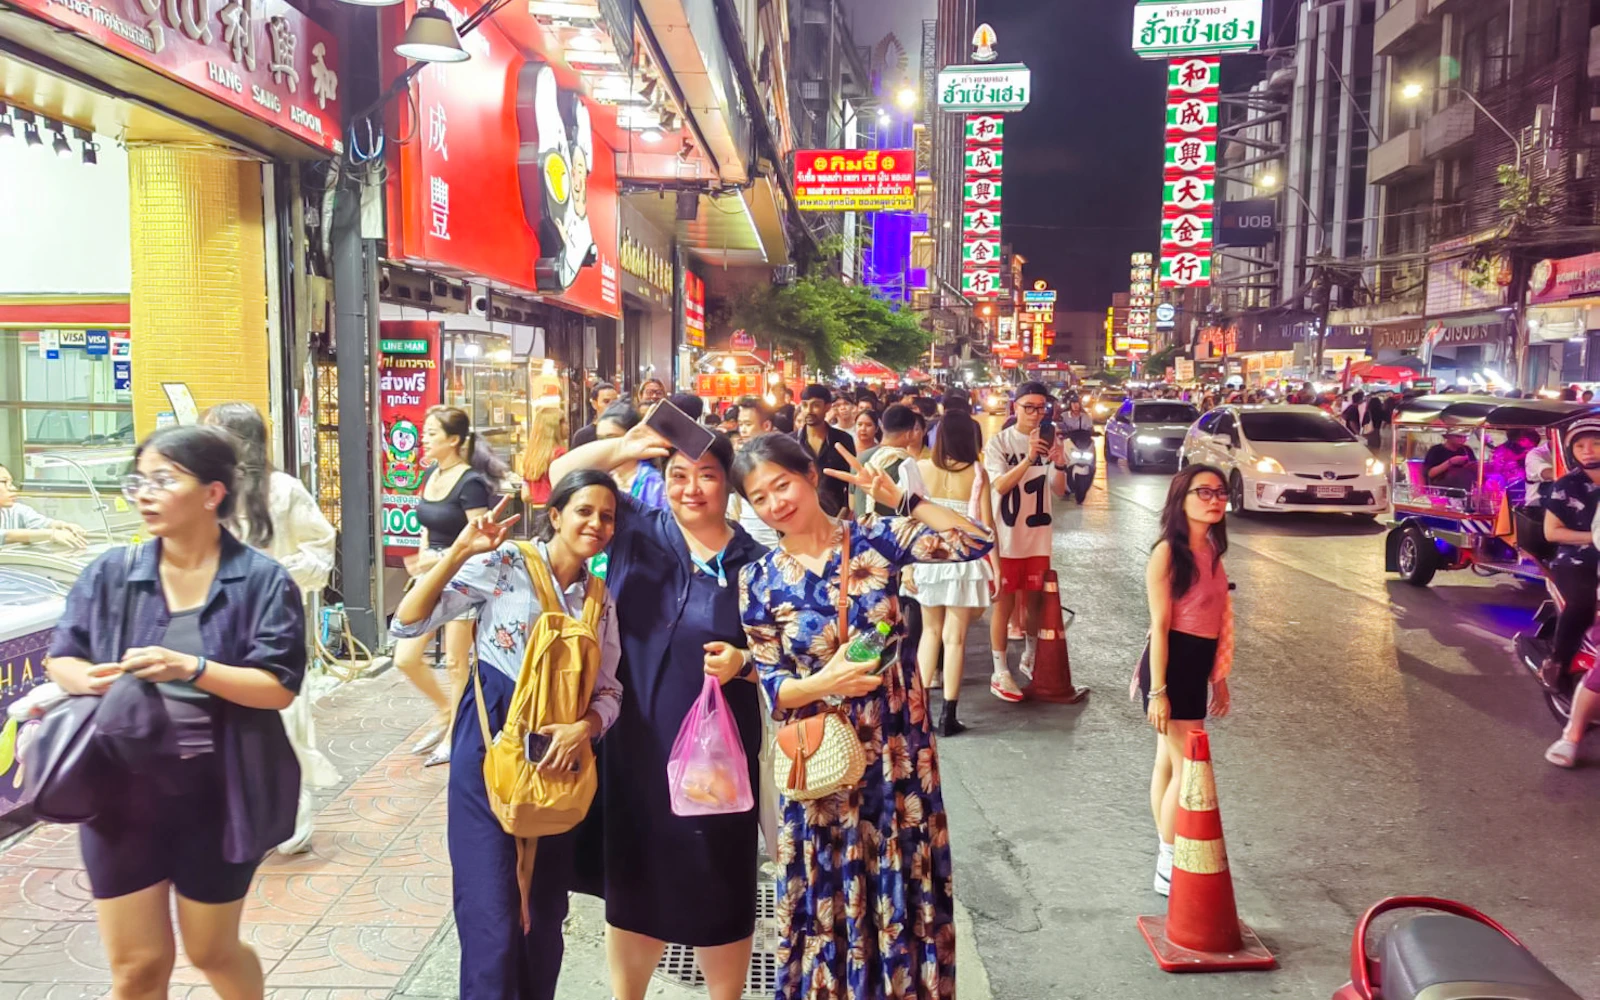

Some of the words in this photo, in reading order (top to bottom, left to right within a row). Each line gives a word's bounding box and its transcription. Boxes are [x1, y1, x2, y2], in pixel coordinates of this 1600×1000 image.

[206, 60, 243, 94] HANG
[252, 84, 281, 113] SANG
[290, 105, 322, 135] AROON
[1171, 63, 1207, 281] 和成興大金行
[971, 119, 995, 291] 和成興大金行
[1238, 215, 1271, 228] UOB
[63, 333, 84, 342] VISA
[88, 335, 106, 344] VISA
[382, 342, 403, 351] LINE
[404, 342, 425, 351] MAN
[380, 370, 426, 392] ส่งฟรี
[1001, 475, 1052, 528] 01
